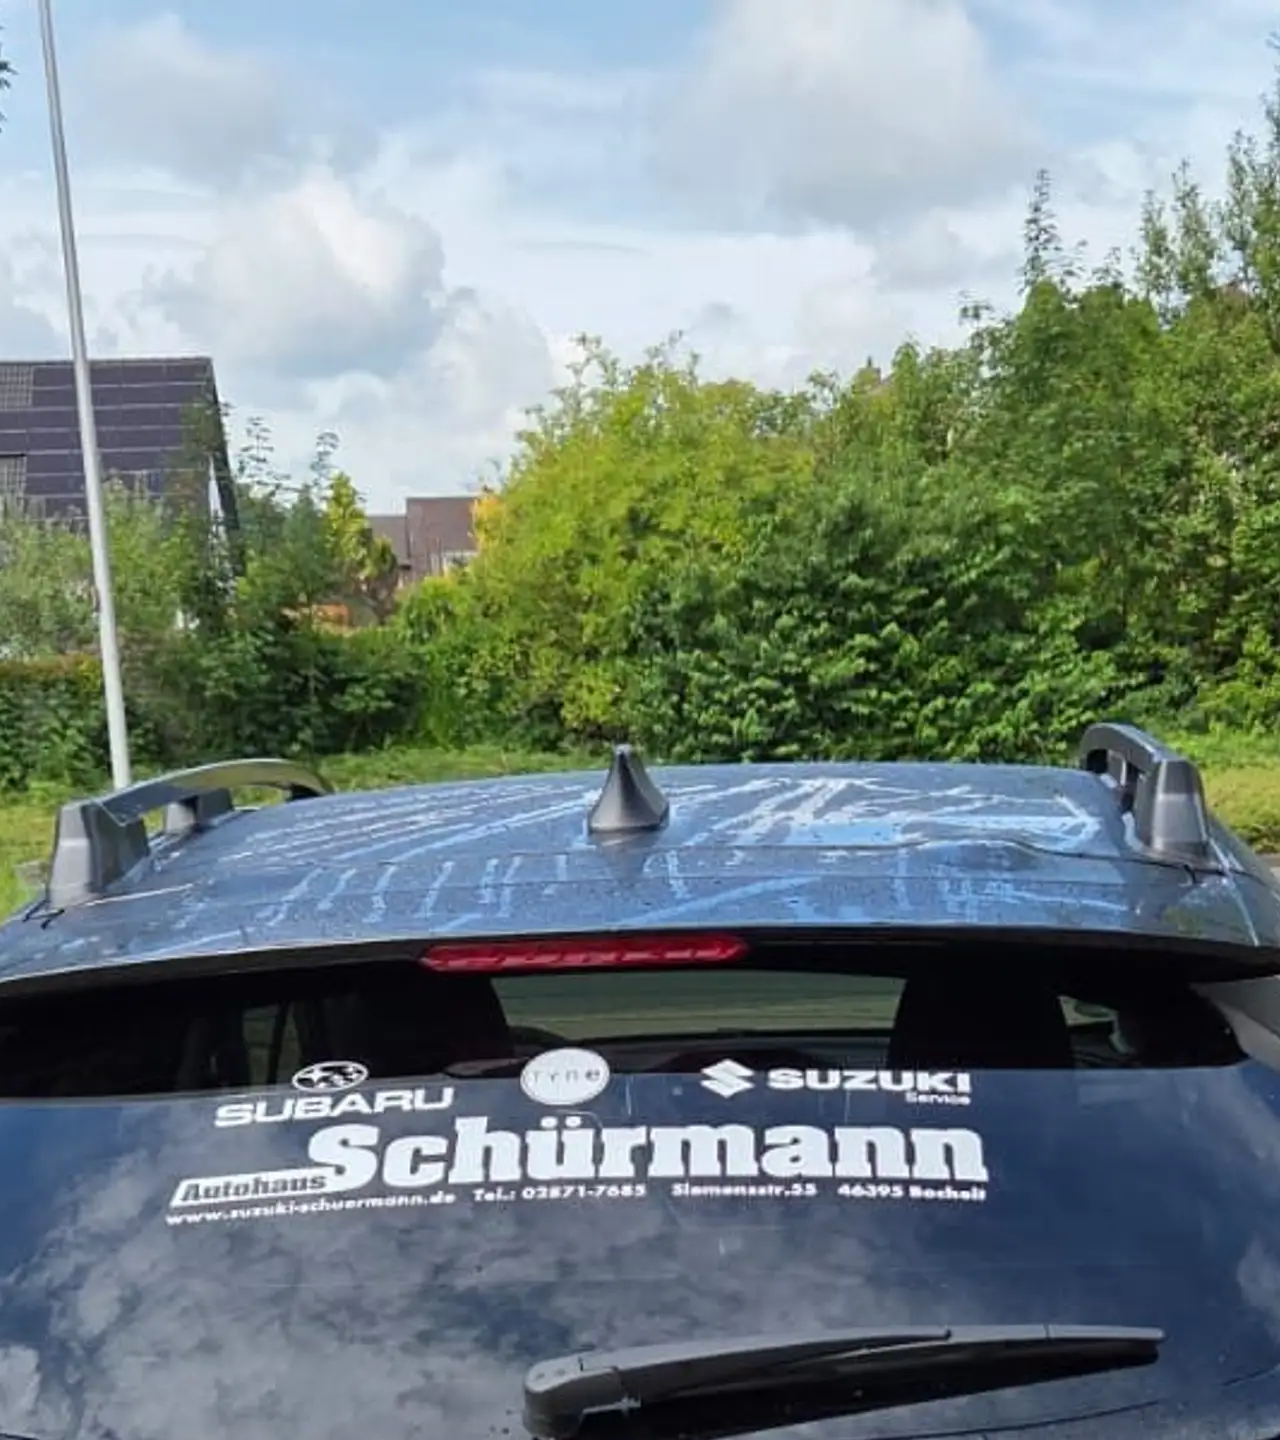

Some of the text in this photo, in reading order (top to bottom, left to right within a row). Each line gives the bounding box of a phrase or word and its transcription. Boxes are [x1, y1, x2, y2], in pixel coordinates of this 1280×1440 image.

[767, 1067, 971, 1093] SUZUKI
[213, 1087, 455, 1128] SUBARU
[905, 1090, 971, 1106] Service
[180, 1115, 989, 1202] Autohaus Schürmann
